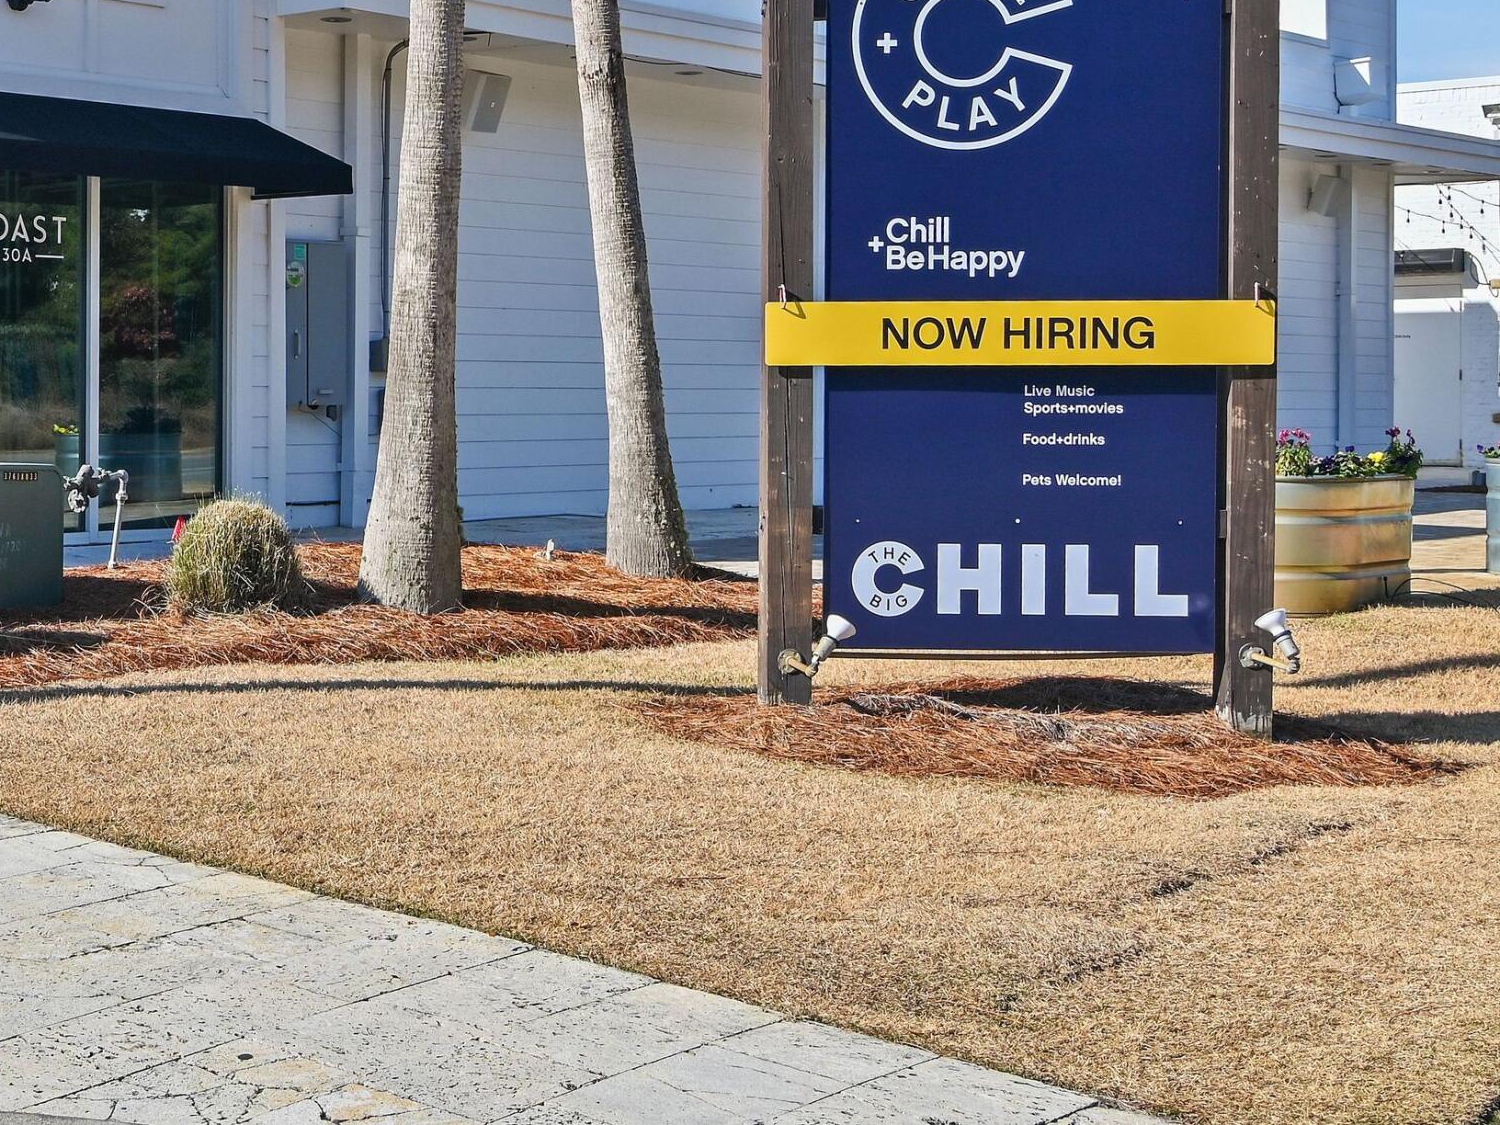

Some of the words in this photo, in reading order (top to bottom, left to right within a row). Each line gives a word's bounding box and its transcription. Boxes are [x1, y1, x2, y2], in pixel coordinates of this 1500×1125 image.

[902, 77, 1025, 131] PLAY
[886, 217, 950, 243] Chill
[2, 248, 32, 263] 30A
[882, 317, 986, 350] NOW
[1003, 317, 1155, 350] HIRING
[1024, 384, 1052, 396] Live
[1056, 384, 1095, 397] Music
[1023, 402, 1124, 417] Sports+movies
[1022, 432, 1106, 446] Food+drinks
[1022, 473, 1052, 486] Pets
[1055, 473, 1122, 486] Welcome!
[868, 547, 911, 566] THE
[852, 541, 1189, 617] CHILL
[869, 594, 908, 611] BIG
